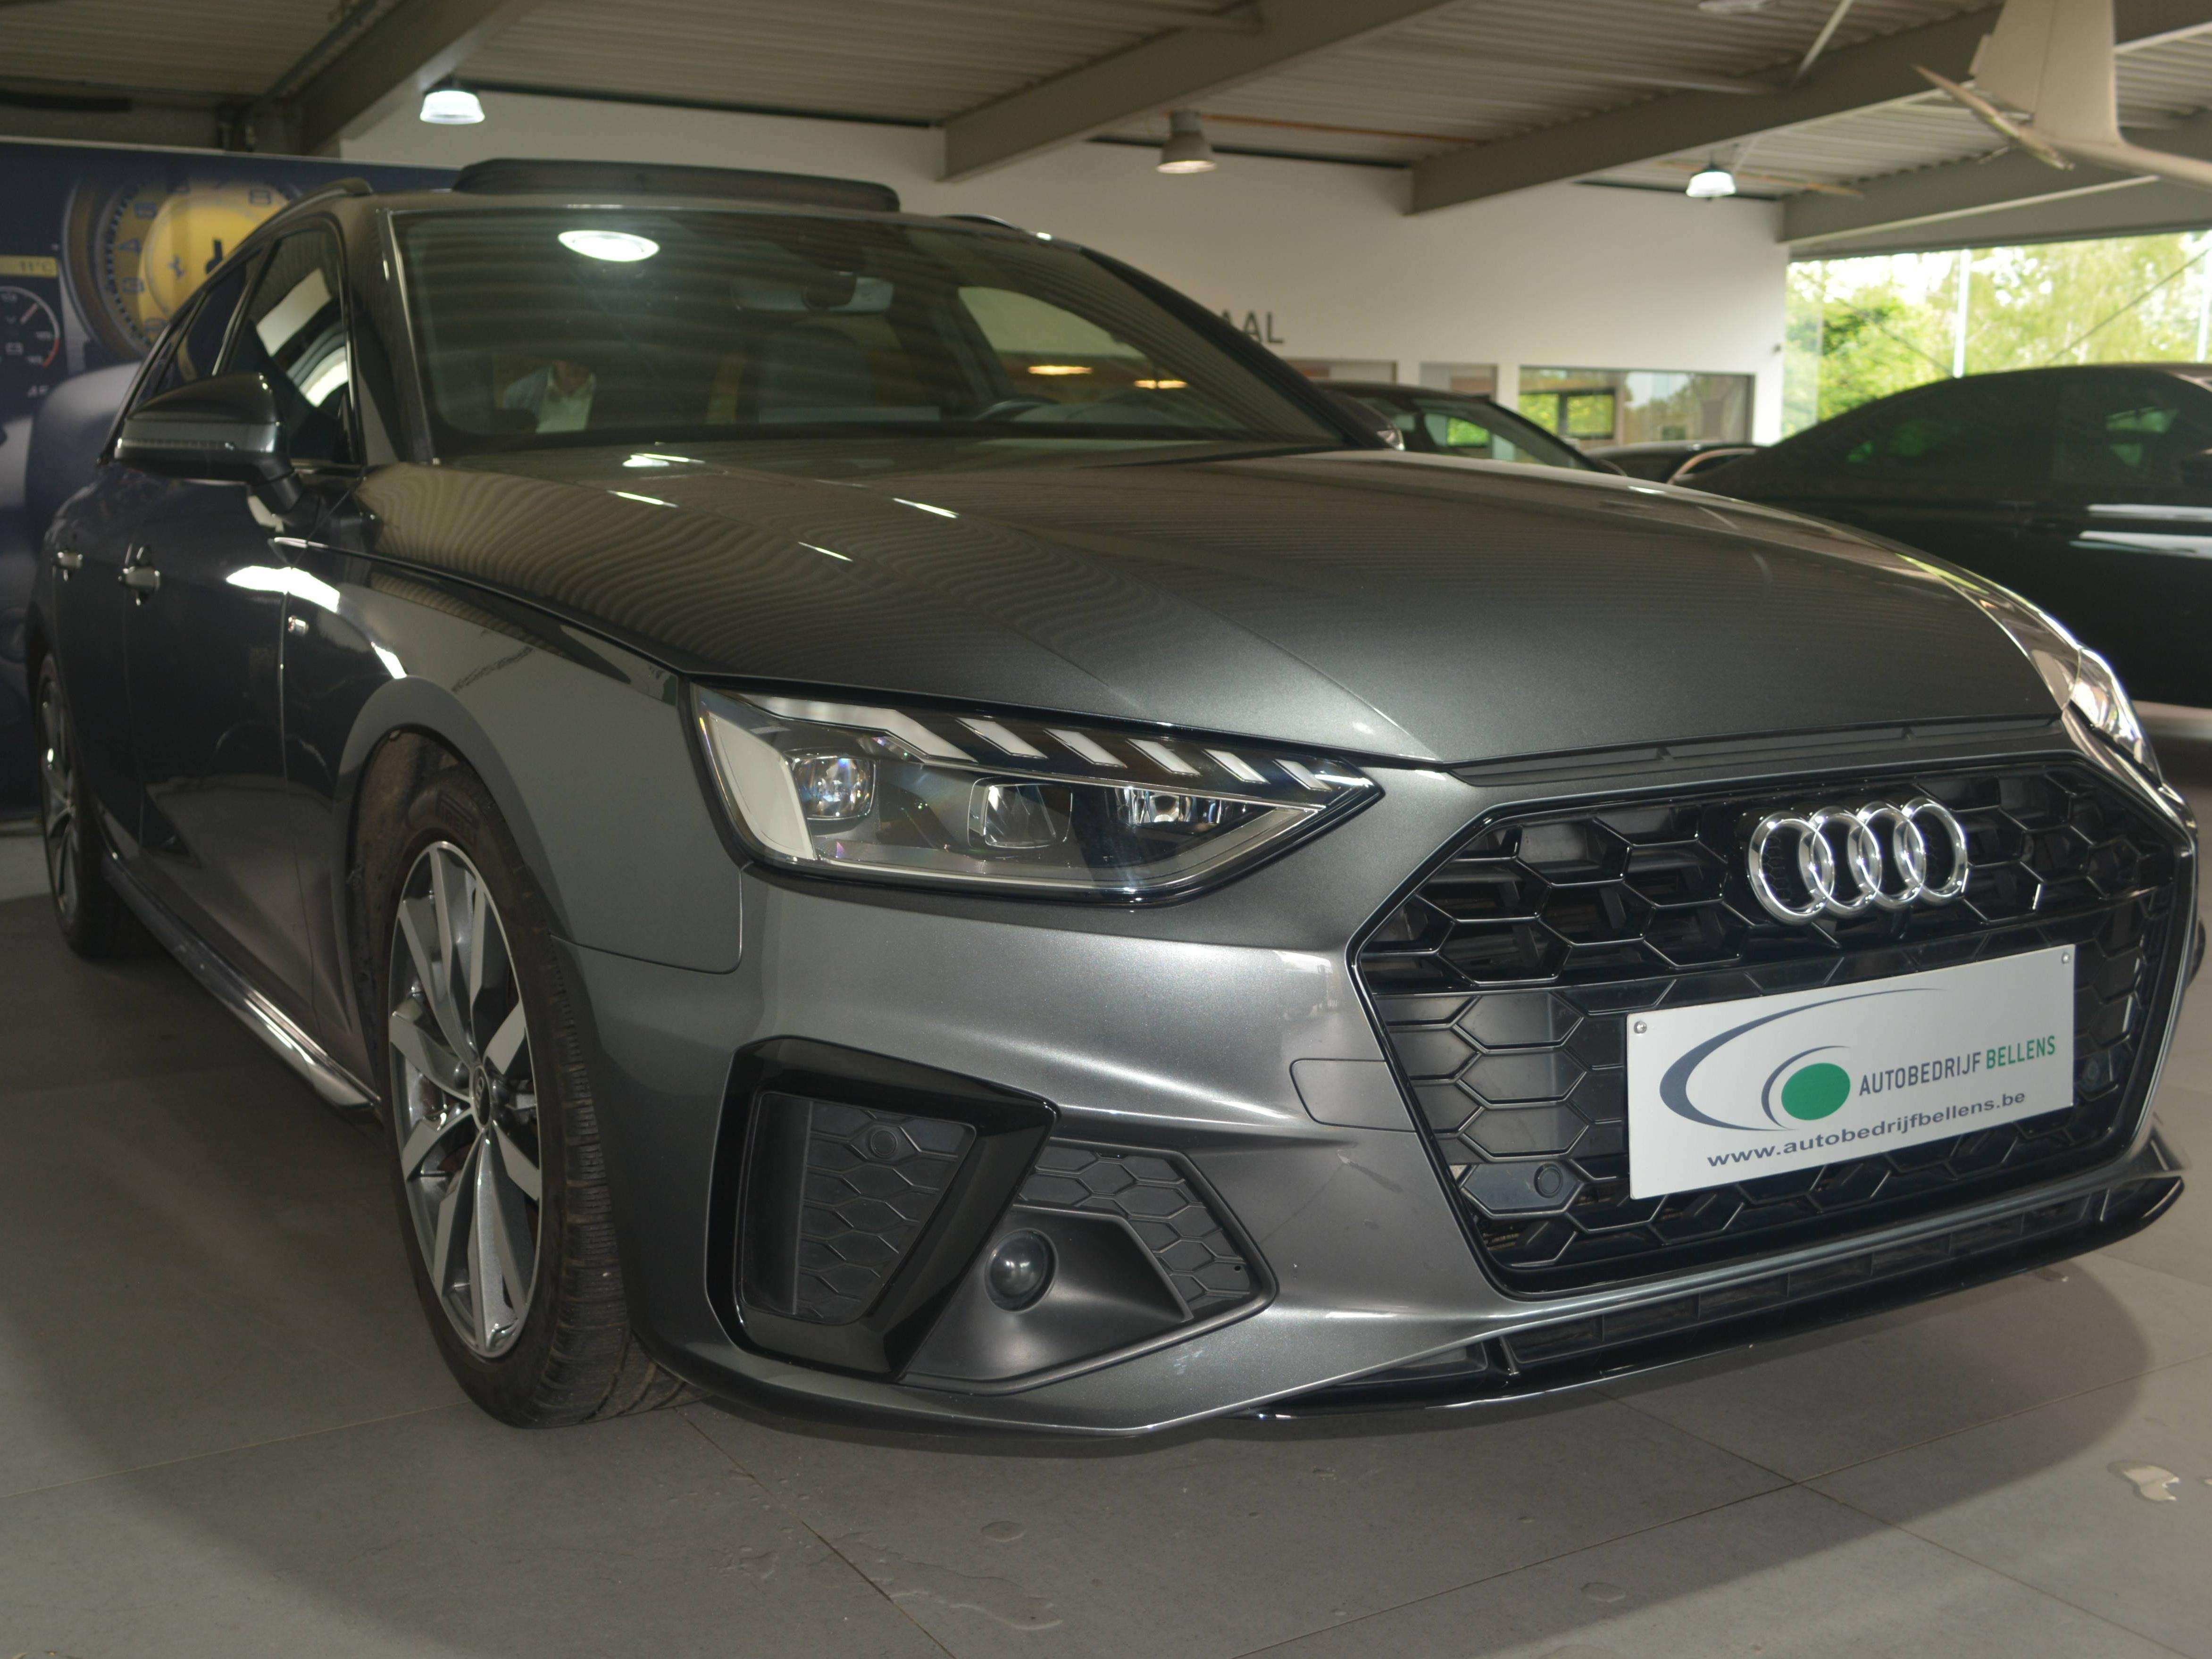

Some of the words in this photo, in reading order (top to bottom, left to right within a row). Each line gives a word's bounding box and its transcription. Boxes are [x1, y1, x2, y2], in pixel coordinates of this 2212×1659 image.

[1859, 1051, 1981, 1096] AUTOBEDRIJF
[1987, 1035, 2056, 1069] BELLENS
[1707, 1092, 2025, 1167] www.autobedrijfbellens.be
